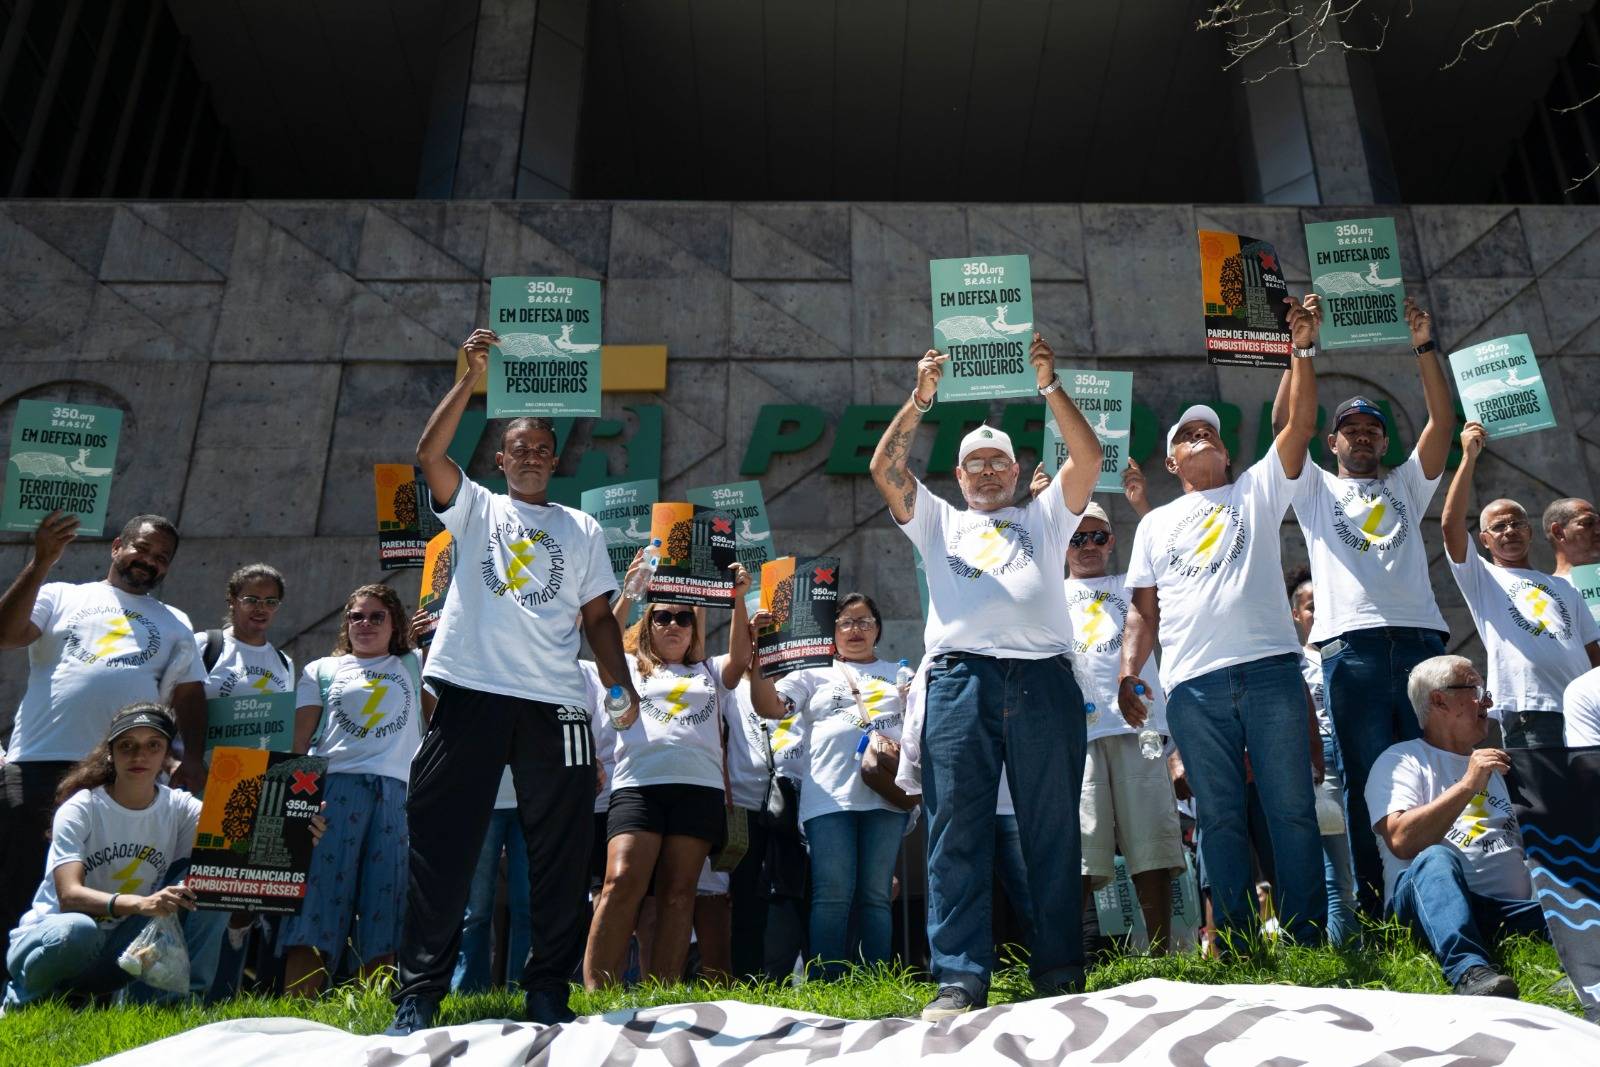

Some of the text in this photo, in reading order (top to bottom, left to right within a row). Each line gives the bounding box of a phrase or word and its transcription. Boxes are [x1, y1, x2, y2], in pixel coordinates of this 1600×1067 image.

[1336, 224, 1374, 237] 350.org
[1338, 236, 1374, 246] BRASIL
[1316, 246, 1391, 265] EM DEFESA DOS
[962, 262, 1005, 276] 350.org
[964, 276, 1004, 286] BRASIL
[527, 281, 573, 296] 350.org
[527, 295, 572, 304] BRASIL
[940, 288, 1021, 307] EM DEFESA DOS
[1327, 293, 1397, 313] TERRITÓRIOS
[499, 308, 590, 323] EM DEFESA DOS
[1332, 308, 1399, 328] PESQUEIROS
[1207, 329, 1290, 342] PAREM DE FINANCIAR OS
[948, 341, 1024, 362] TERRITÓRIOS
[1208, 340, 1289, 353] COMBUSTÍVEIS FÓSSEIS
[503, 360, 589, 377] TERRITÓRIOS
[952, 358, 1025, 378] PESQUEIROS
[1460, 355, 1527, 381] EM DEFESA DOS
[506, 377, 588, 393] PESQUEIROS
[1075, 374, 1110, 388] 350.org
[1075, 387, 1109, 395] BRASIL
[1103, 399, 1122, 412] DOS
[1474, 389, 1538, 414] TERRITÓRIOS
[52, 407, 95, 422] 350.org
[1480, 401, 1541, 424] PESQUEIROS
[51, 419, 92, 430] BRASIL
[22, 428, 108, 448] EM DEFESA DOS
[19, 478, 98, 499] TERRITÓRIOS
[604, 488, 637, 500] 350.org
[711, 488, 744, 500] 350.org
[19, 495, 96, 514] PESQUEIROS
[605, 496, 637, 506] BRASIL
[714, 498, 744, 507] BRASIL
[600, 506, 630, 521] DEFESA
[632, 504, 650, 516] DOS
[743, 506, 760, 518] DOS
[381, 541, 406, 549] PAREM
[406, 540, 416, 548] DE
[710, 535, 735, 545] 350.org
[650, 575, 734, 589] PAREM DE FINANCIAR OS
[650, 583, 732, 597] COMBUSTÍVEIS FÓSSEIS
[811, 587, 837, 597] 350.org
[1581, 588, 1595, 600] EM
[758, 637, 834, 657] PAREM DE FINANCIAR OS
[759, 649, 801, 667] COMBUSTÍVEIS
[801, 646, 831, 657] FÓSSEIS
[232, 699, 273, 712] 350.org
[557, 713, 587, 722] adidas
[208, 719, 285, 739] EM DEFESA DOS
[286, 800, 319, 813] 350.org
[190, 865, 305, 883] PAREM DE FINANCIAR OS
[1114, 863, 1128, 882] DOS
[188, 878, 300, 897] COMBUSTÍVEIS FÓSSEIS
[1118, 882, 1133, 913] DEFESA
